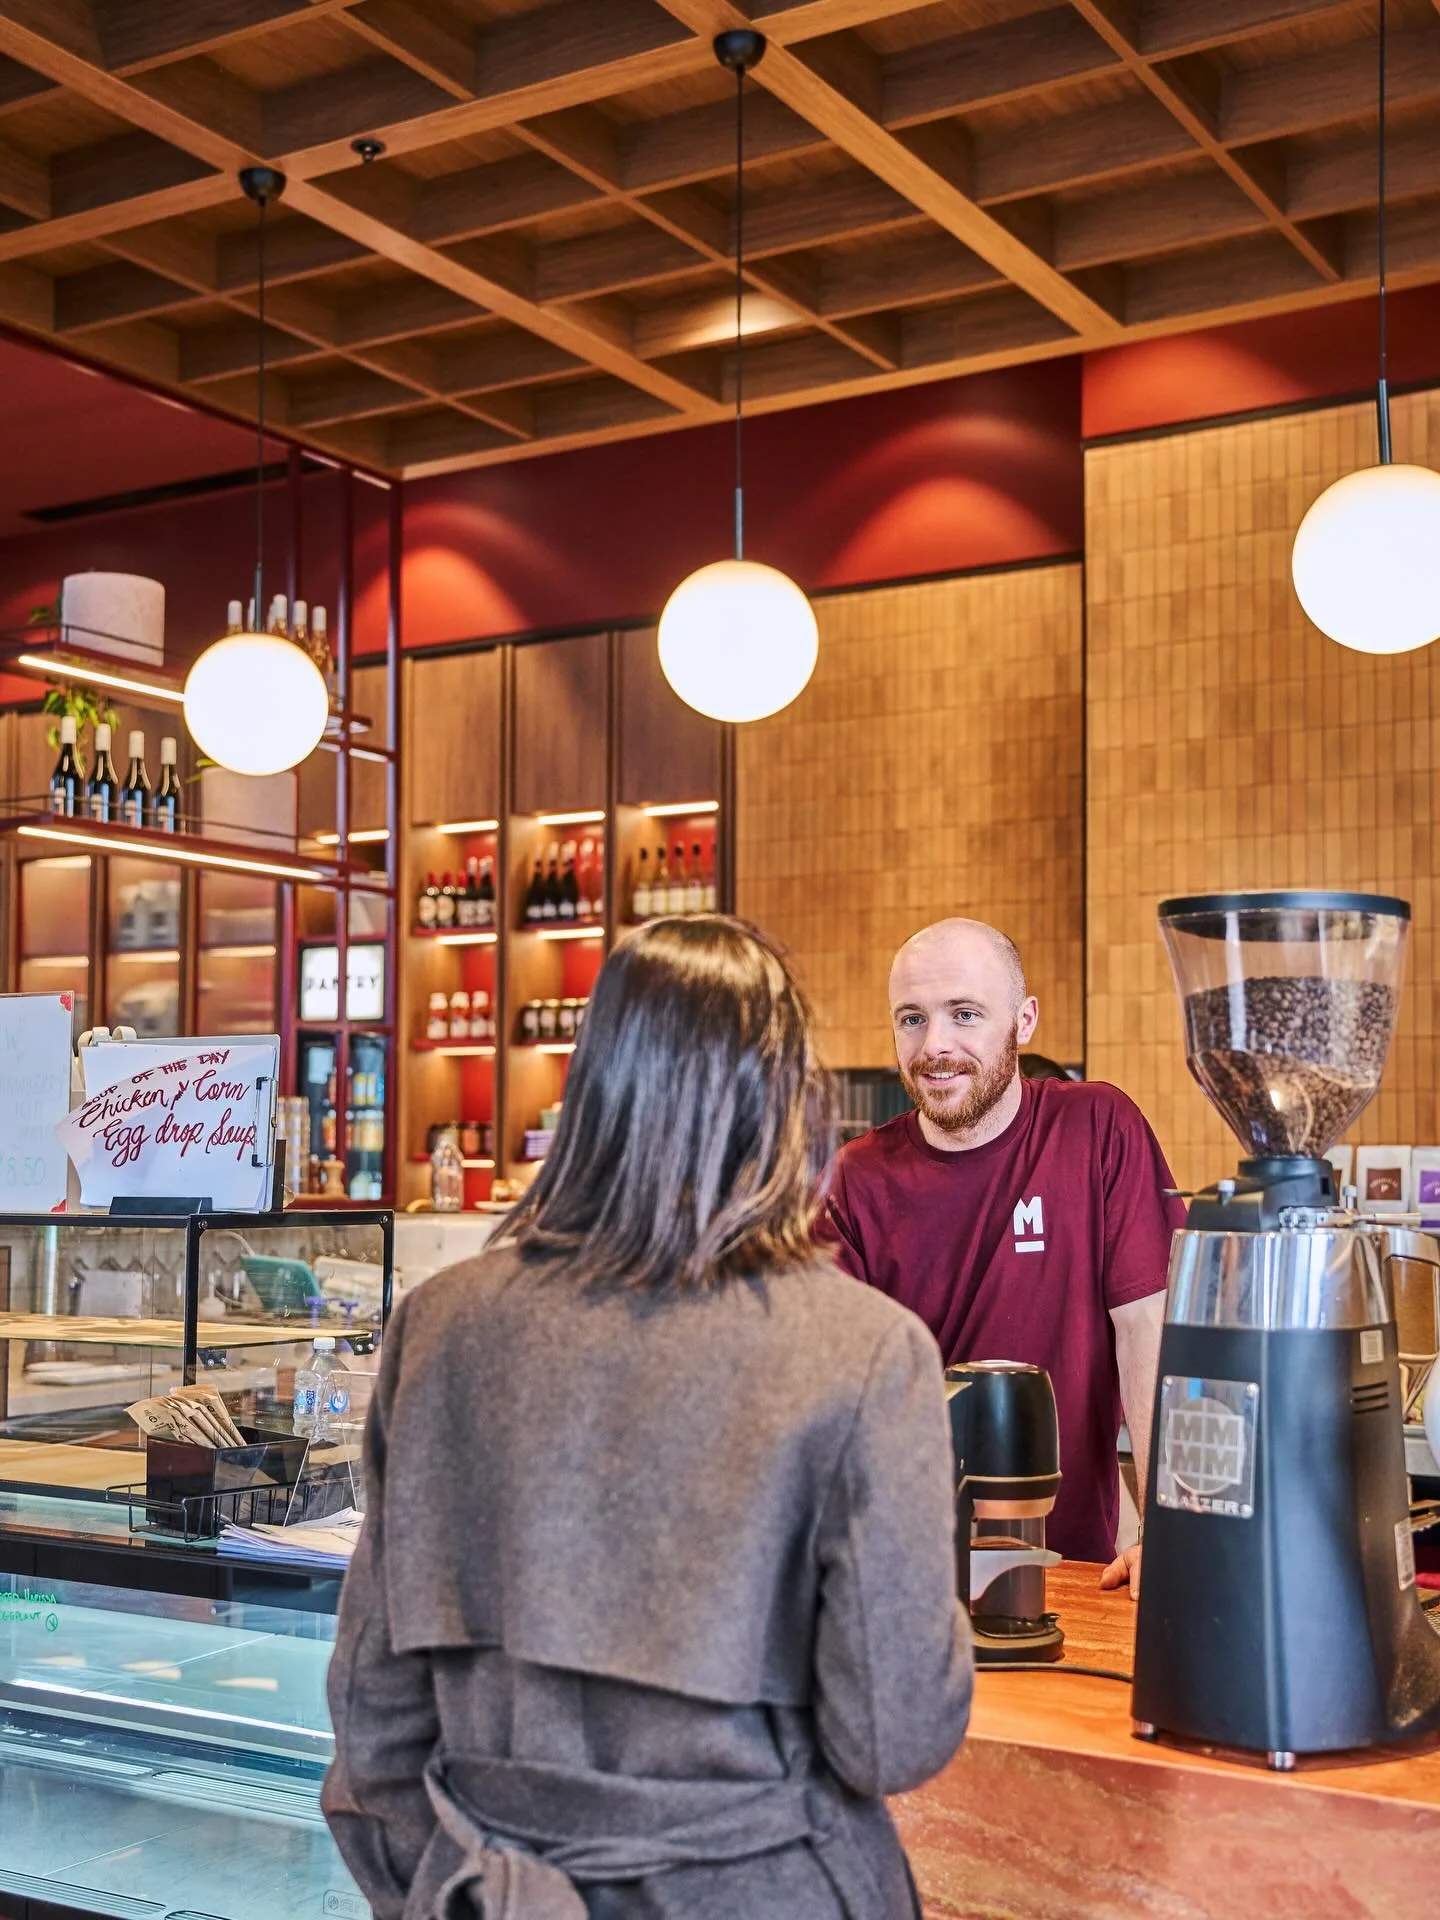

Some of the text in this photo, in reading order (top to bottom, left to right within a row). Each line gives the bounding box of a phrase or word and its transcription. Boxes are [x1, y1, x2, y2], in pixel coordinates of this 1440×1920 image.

[72, 1089, 169, 1128] Chicken
[192, 1069, 251, 1101] Corn
[81, 1049, 231, 1111] SOUP OF THE DAY
[93, 1118, 150, 1168] Egg
[155, 1112, 204, 1158] drop
[205, 1107, 257, 1162] Soup
[1013, 1196, 1044, 1235] M
